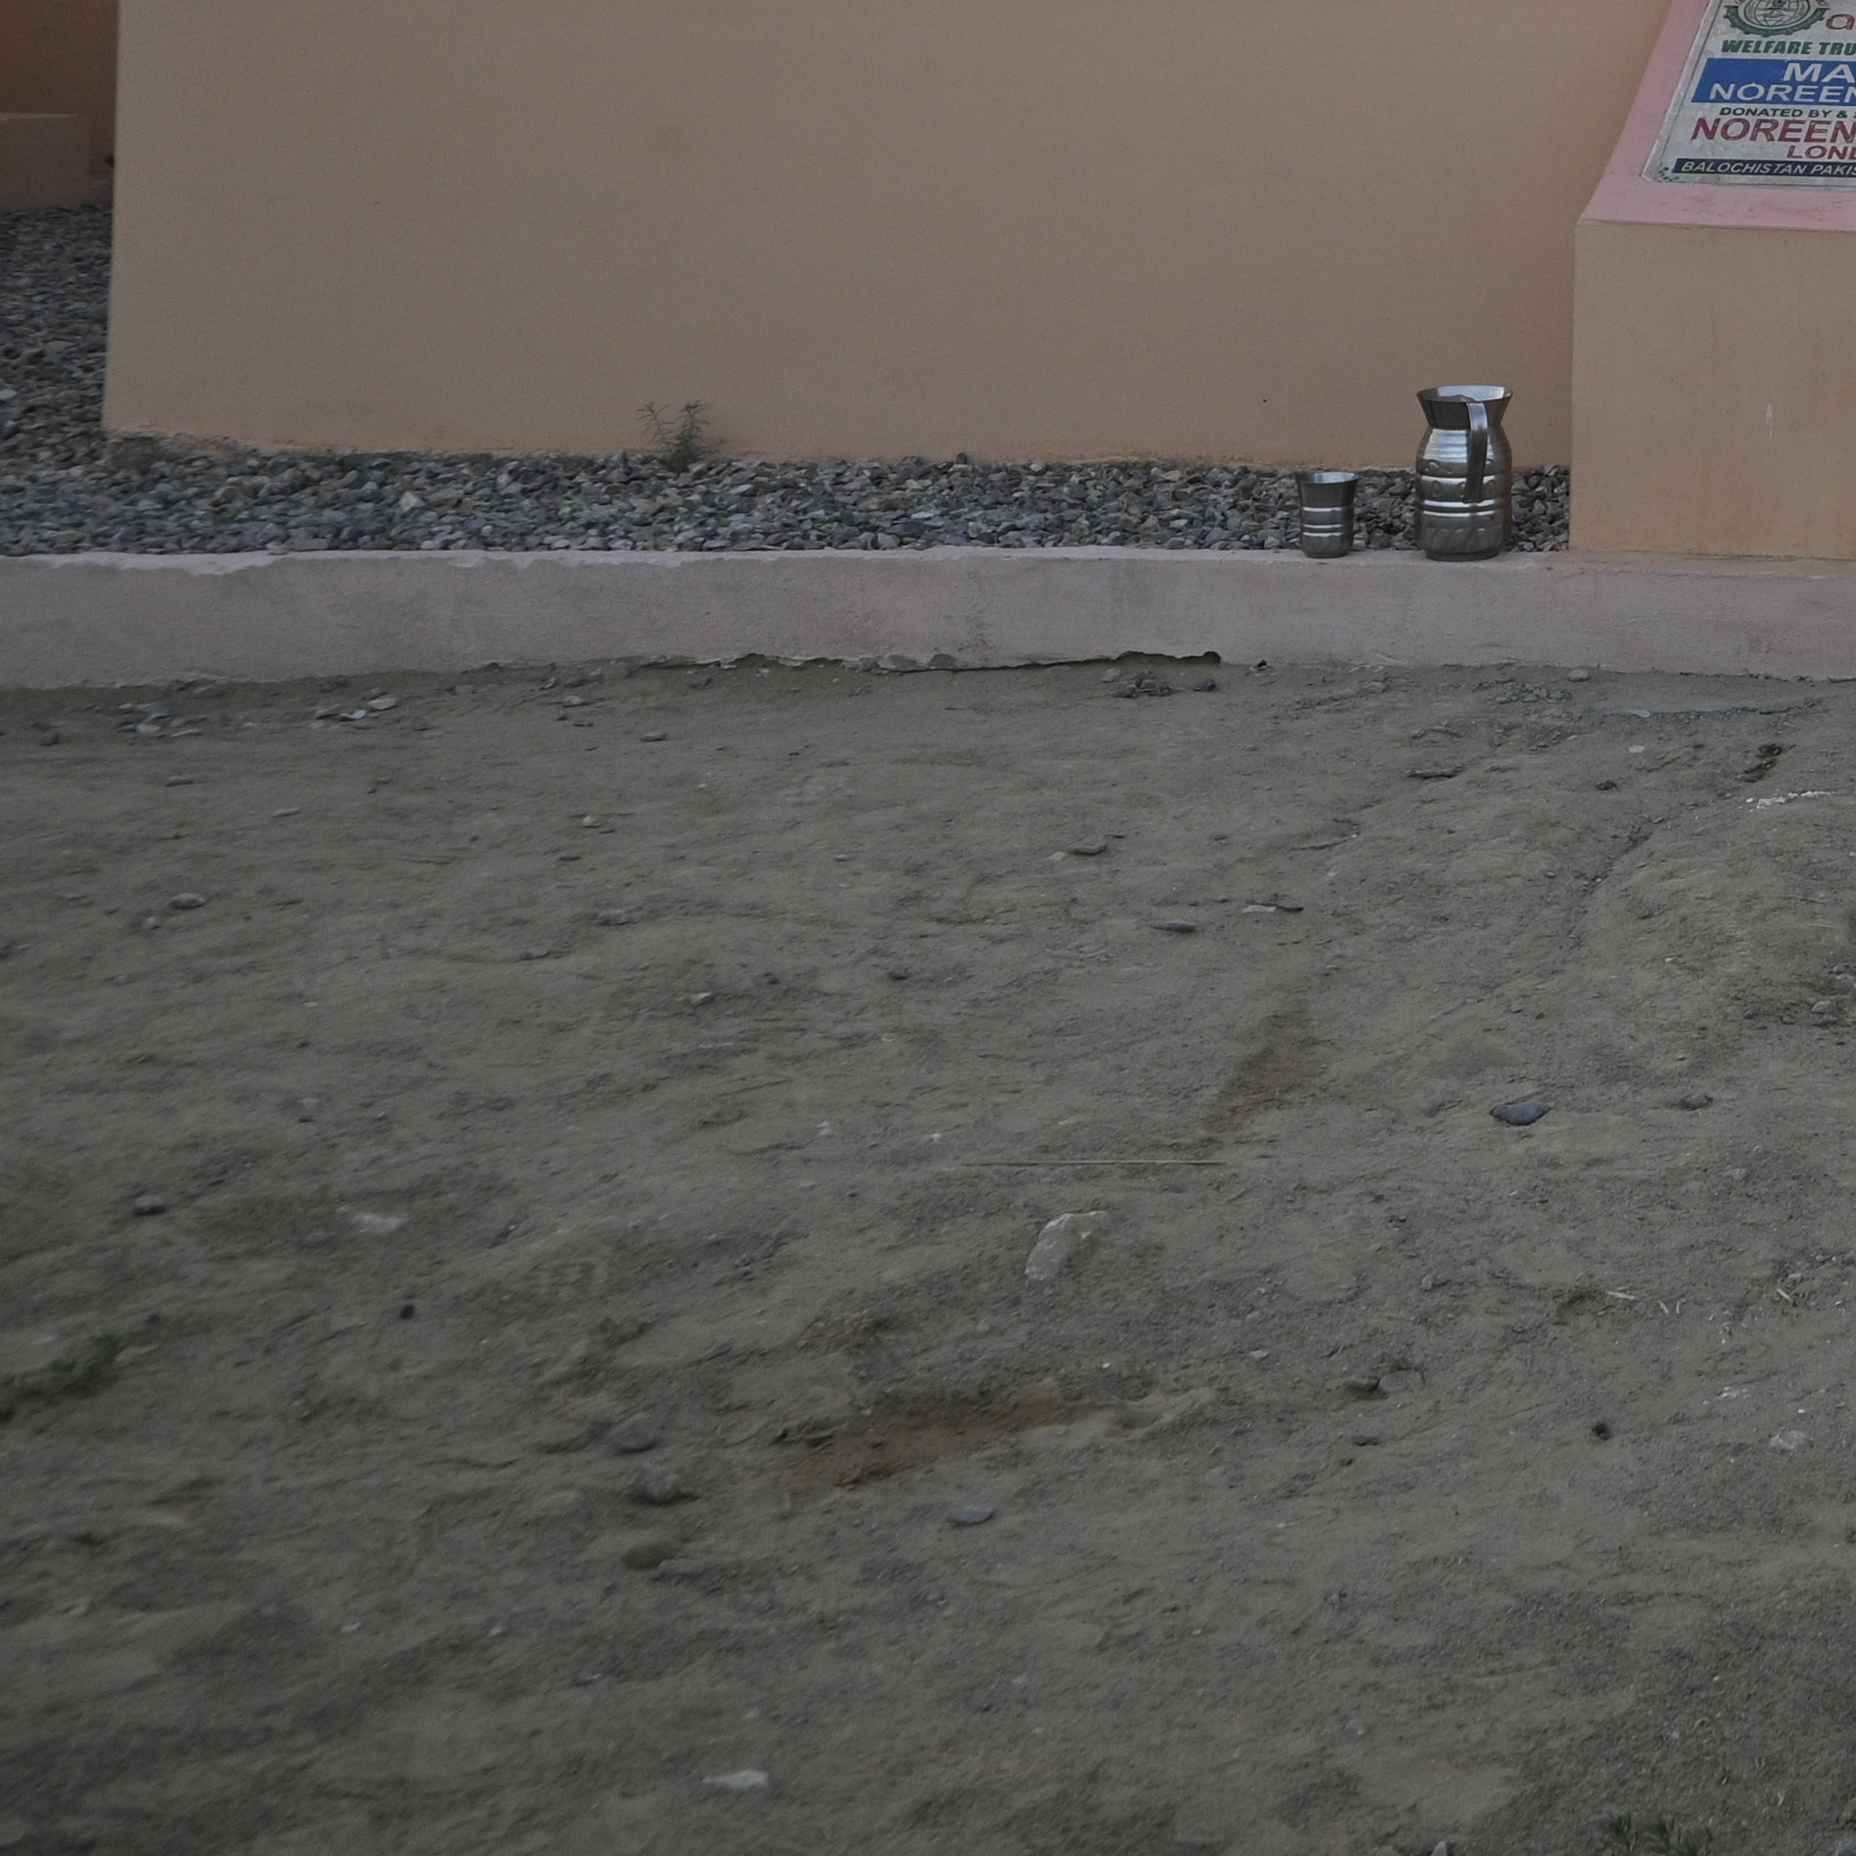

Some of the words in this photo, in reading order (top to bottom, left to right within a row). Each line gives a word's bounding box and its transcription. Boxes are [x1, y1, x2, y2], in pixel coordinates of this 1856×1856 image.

[1721, 39, 1813, 55] WELFARE
[1719, 107, 1803, 118] DONATED
[1808, 109, 1833, 119] BY
[1836, 110, 1848, 119] &
[1681, 161, 1807, 175] BALOCHISTAN
